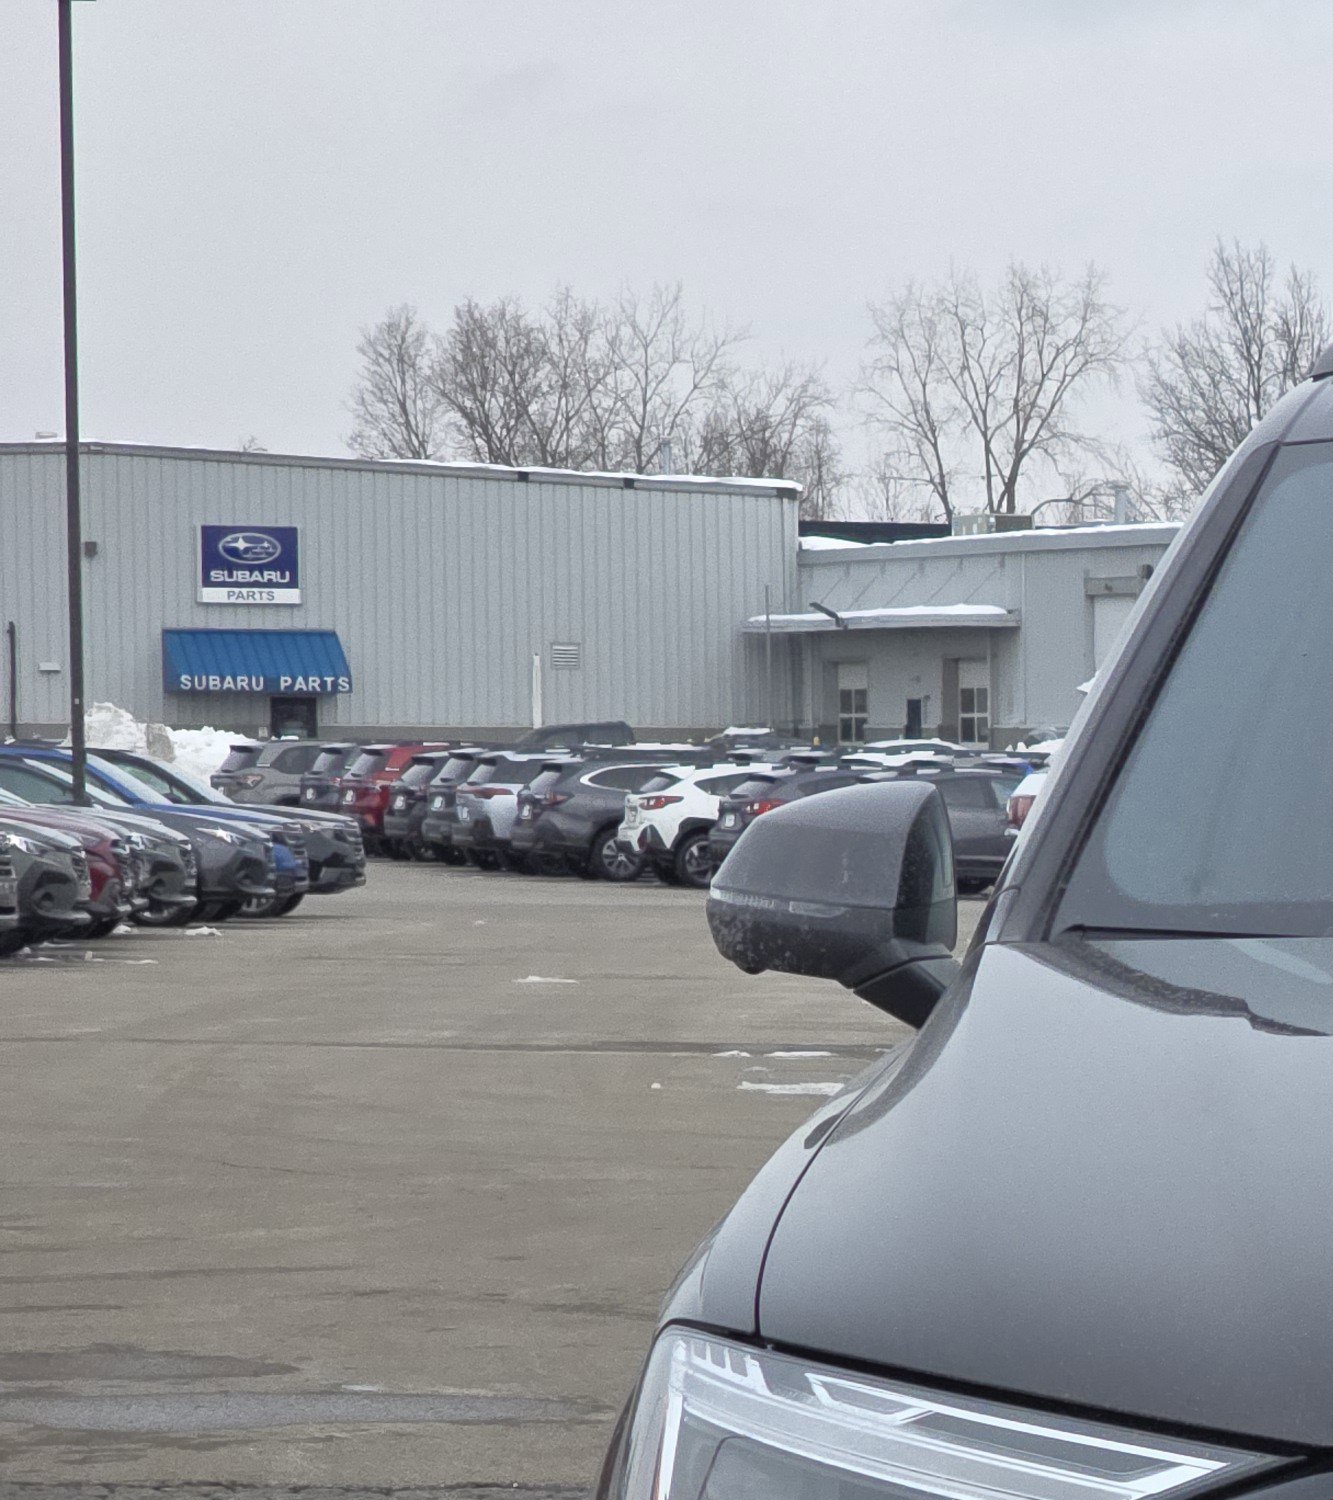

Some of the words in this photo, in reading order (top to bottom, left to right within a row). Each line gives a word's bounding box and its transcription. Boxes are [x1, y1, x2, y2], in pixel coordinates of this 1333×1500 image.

[210, 569, 290, 583] SUBARU
[227, 590, 275, 601] PARTS
[180, 674, 264, 691] SUBARU
[280, 676, 350, 692] PARTS
